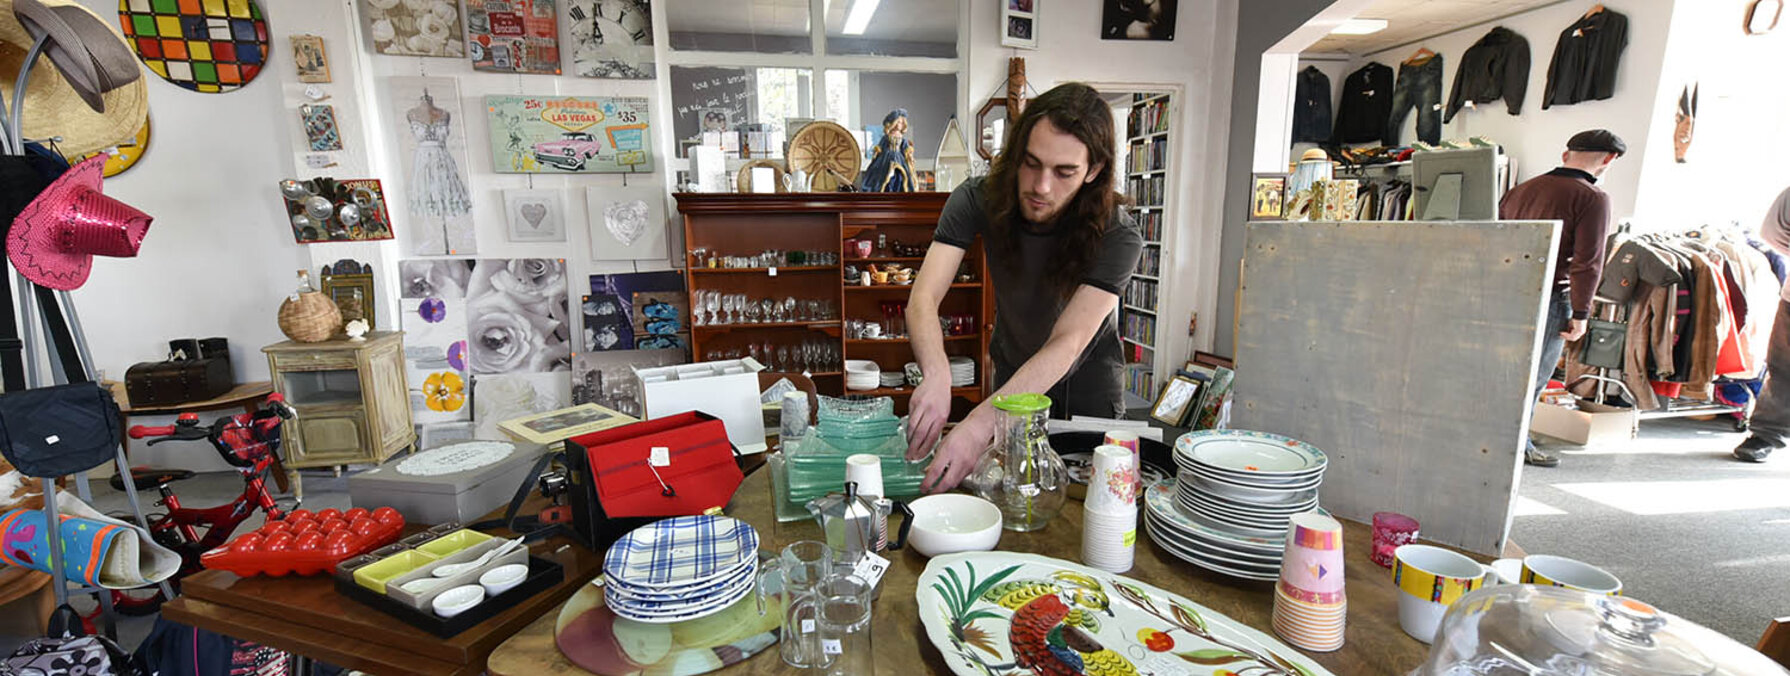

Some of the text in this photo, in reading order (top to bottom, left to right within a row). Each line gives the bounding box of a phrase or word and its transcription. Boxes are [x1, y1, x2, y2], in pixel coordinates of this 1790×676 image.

[552, 114, 597, 122] LAS VEGAS
[618, 111, 637, 123] $35
